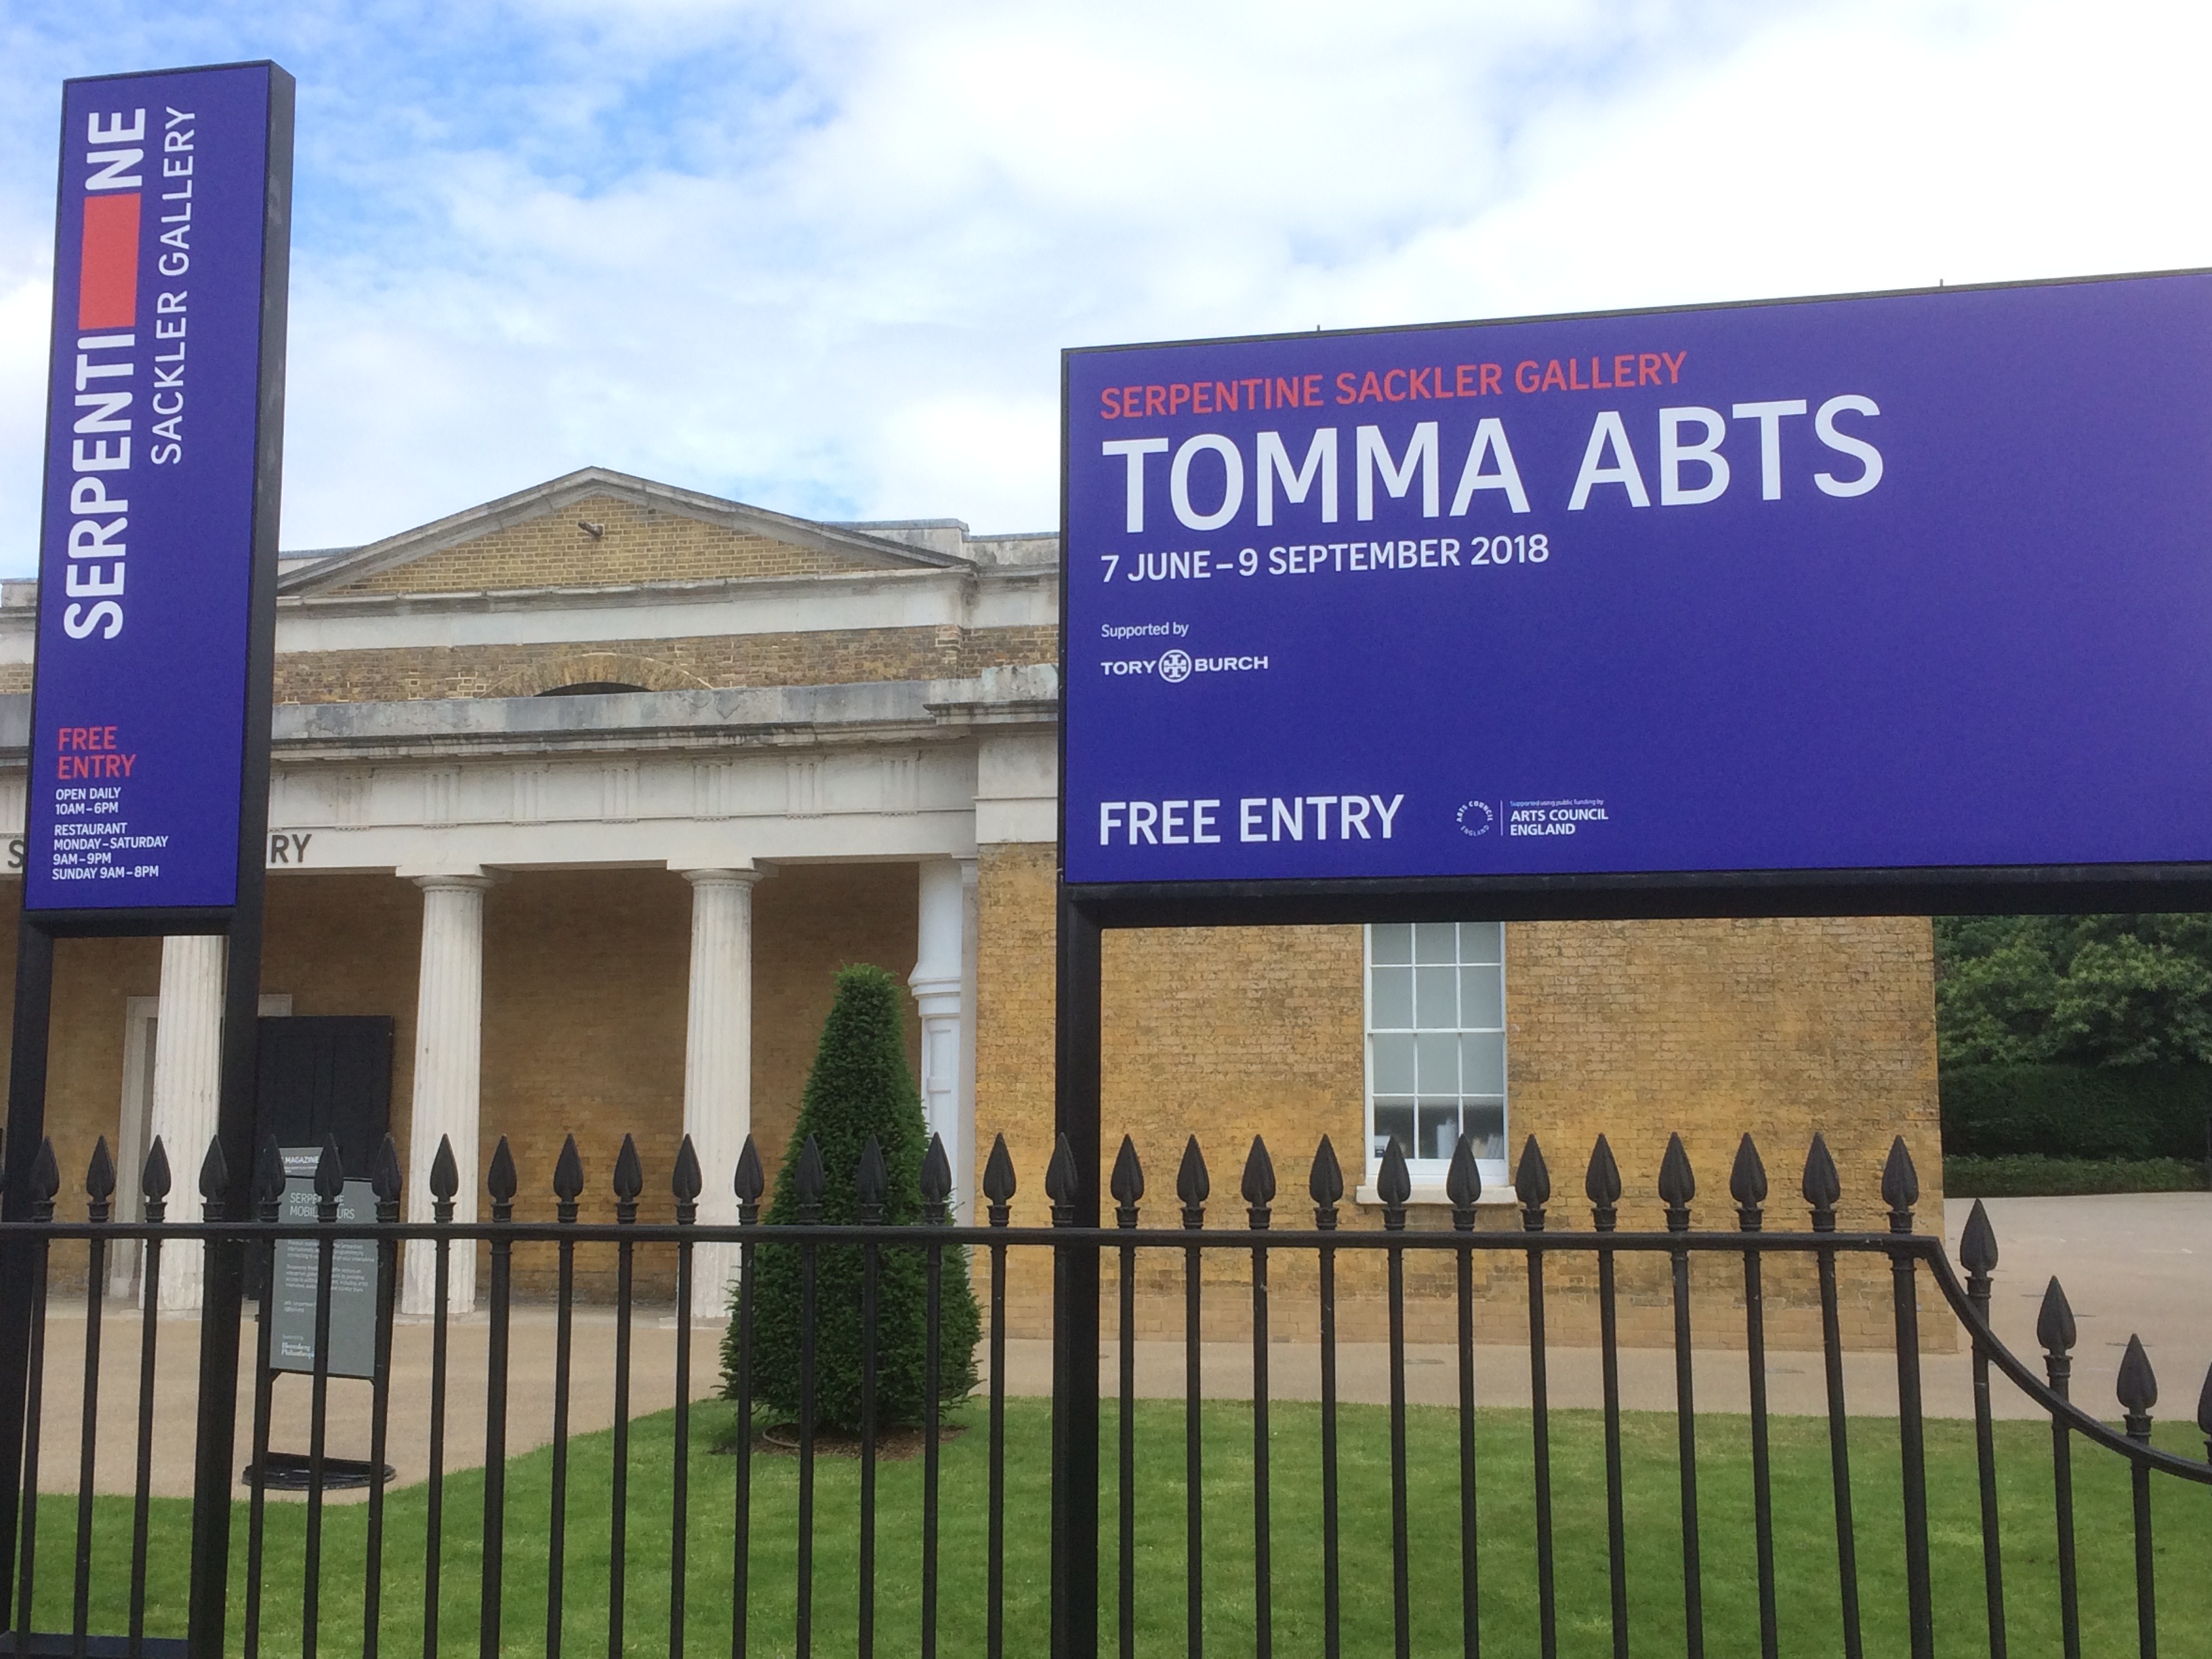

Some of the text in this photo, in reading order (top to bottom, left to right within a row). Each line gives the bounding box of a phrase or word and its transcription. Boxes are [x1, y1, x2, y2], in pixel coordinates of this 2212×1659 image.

[150, 106, 195, 465] SACKLER GALLERY
[1101, 351, 1686, 419] SERPENTINE SACKLER GALLERY
[1102, 394, 1883, 533] TOMMA ABTS
[1101, 554, 1120, 583] 7
[1269, 538, 1460, 575] SEPTEMBER
[1471, 533, 1549, 565] 2018
[1101, 621, 1189, 640] Supported by
[1100, 656, 1269, 676] TORY BURCH
[58, 725, 117, 751] FREE
[57, 754, 136, 780] ENTRY
[56, 786, 121, 801] OPEN DAILY
[1100, 794, 1404, 846] FREE ENTRY
[1510, 808, 1609, 822] ARTS COUNCIL
[54, 822, 128, 836] RESTAURANT
[1510, 823, 1576, 836] ENGLAND
[52, 867, 98, 880] SUNDAY
[285, 1156, 320, 1164] MAGAZINE
[289, 1206, 319, 1217] MOBIL
